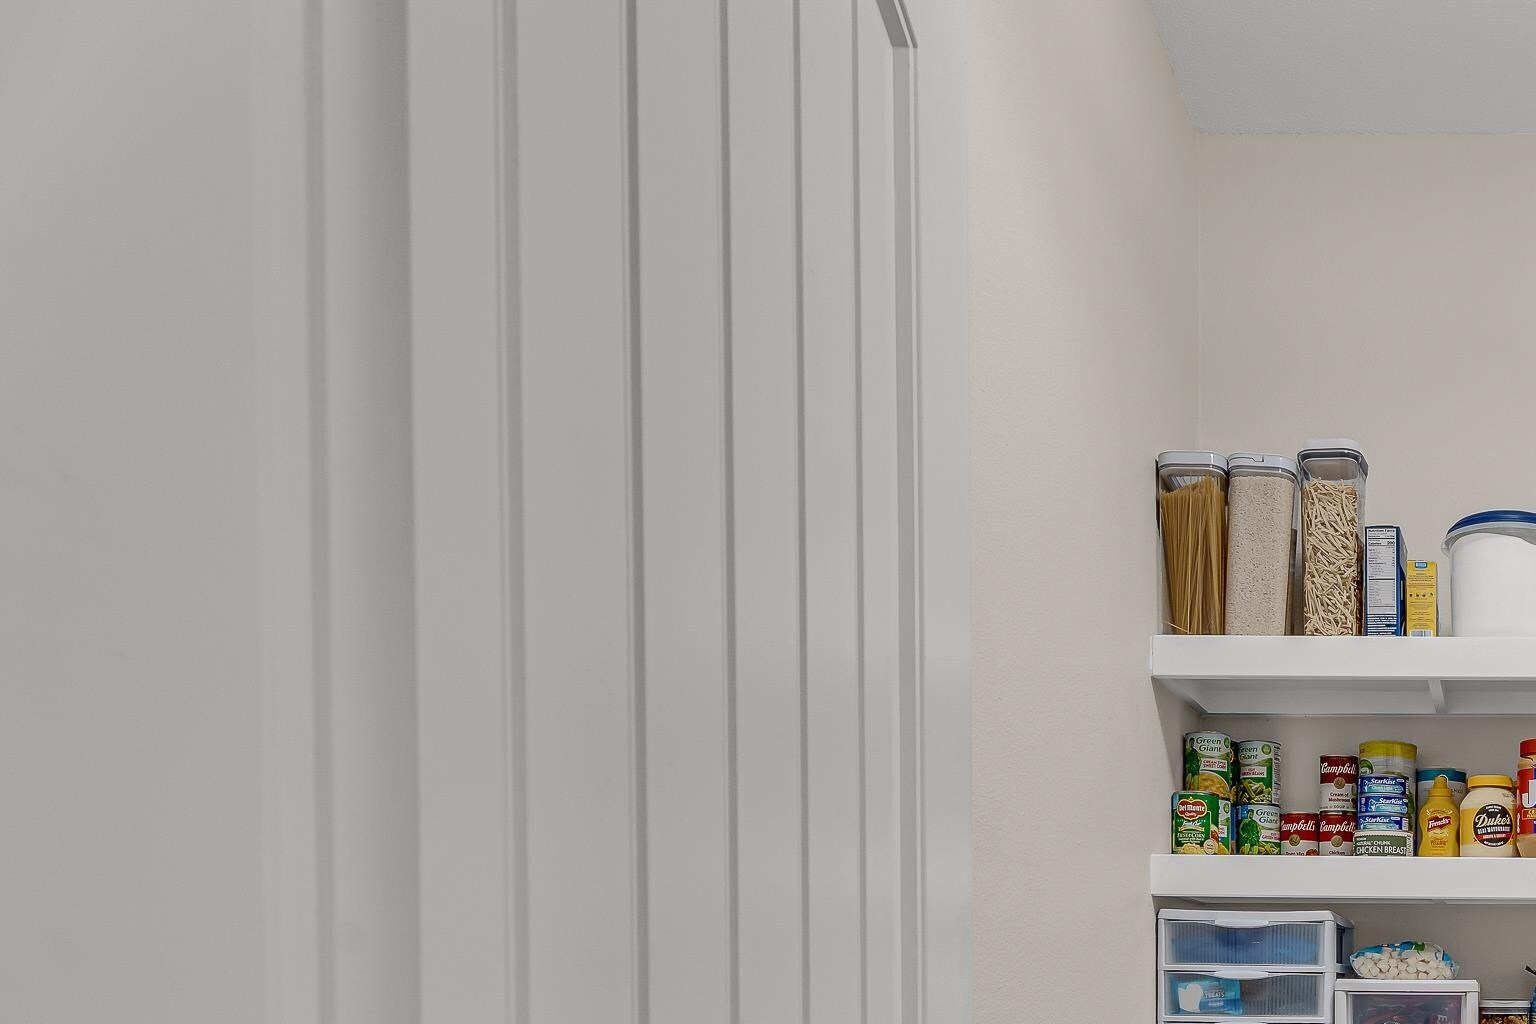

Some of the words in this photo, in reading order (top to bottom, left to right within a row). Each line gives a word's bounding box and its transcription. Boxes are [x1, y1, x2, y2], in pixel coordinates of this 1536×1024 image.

[1195, 736, 1222, 745] Green
[1198, 744, 1222, 753] Giant
[1370, 777, 1396, 785] StarKist
[1378, 797, 1403, 805] StarKist
[1428, 818, 1451, 828] French's
[1475, 813, 1511, 828] Duke's
[1356, 847, 1384, 855] CHICKEN
[1385, 847, 1407, 855] BREAST
